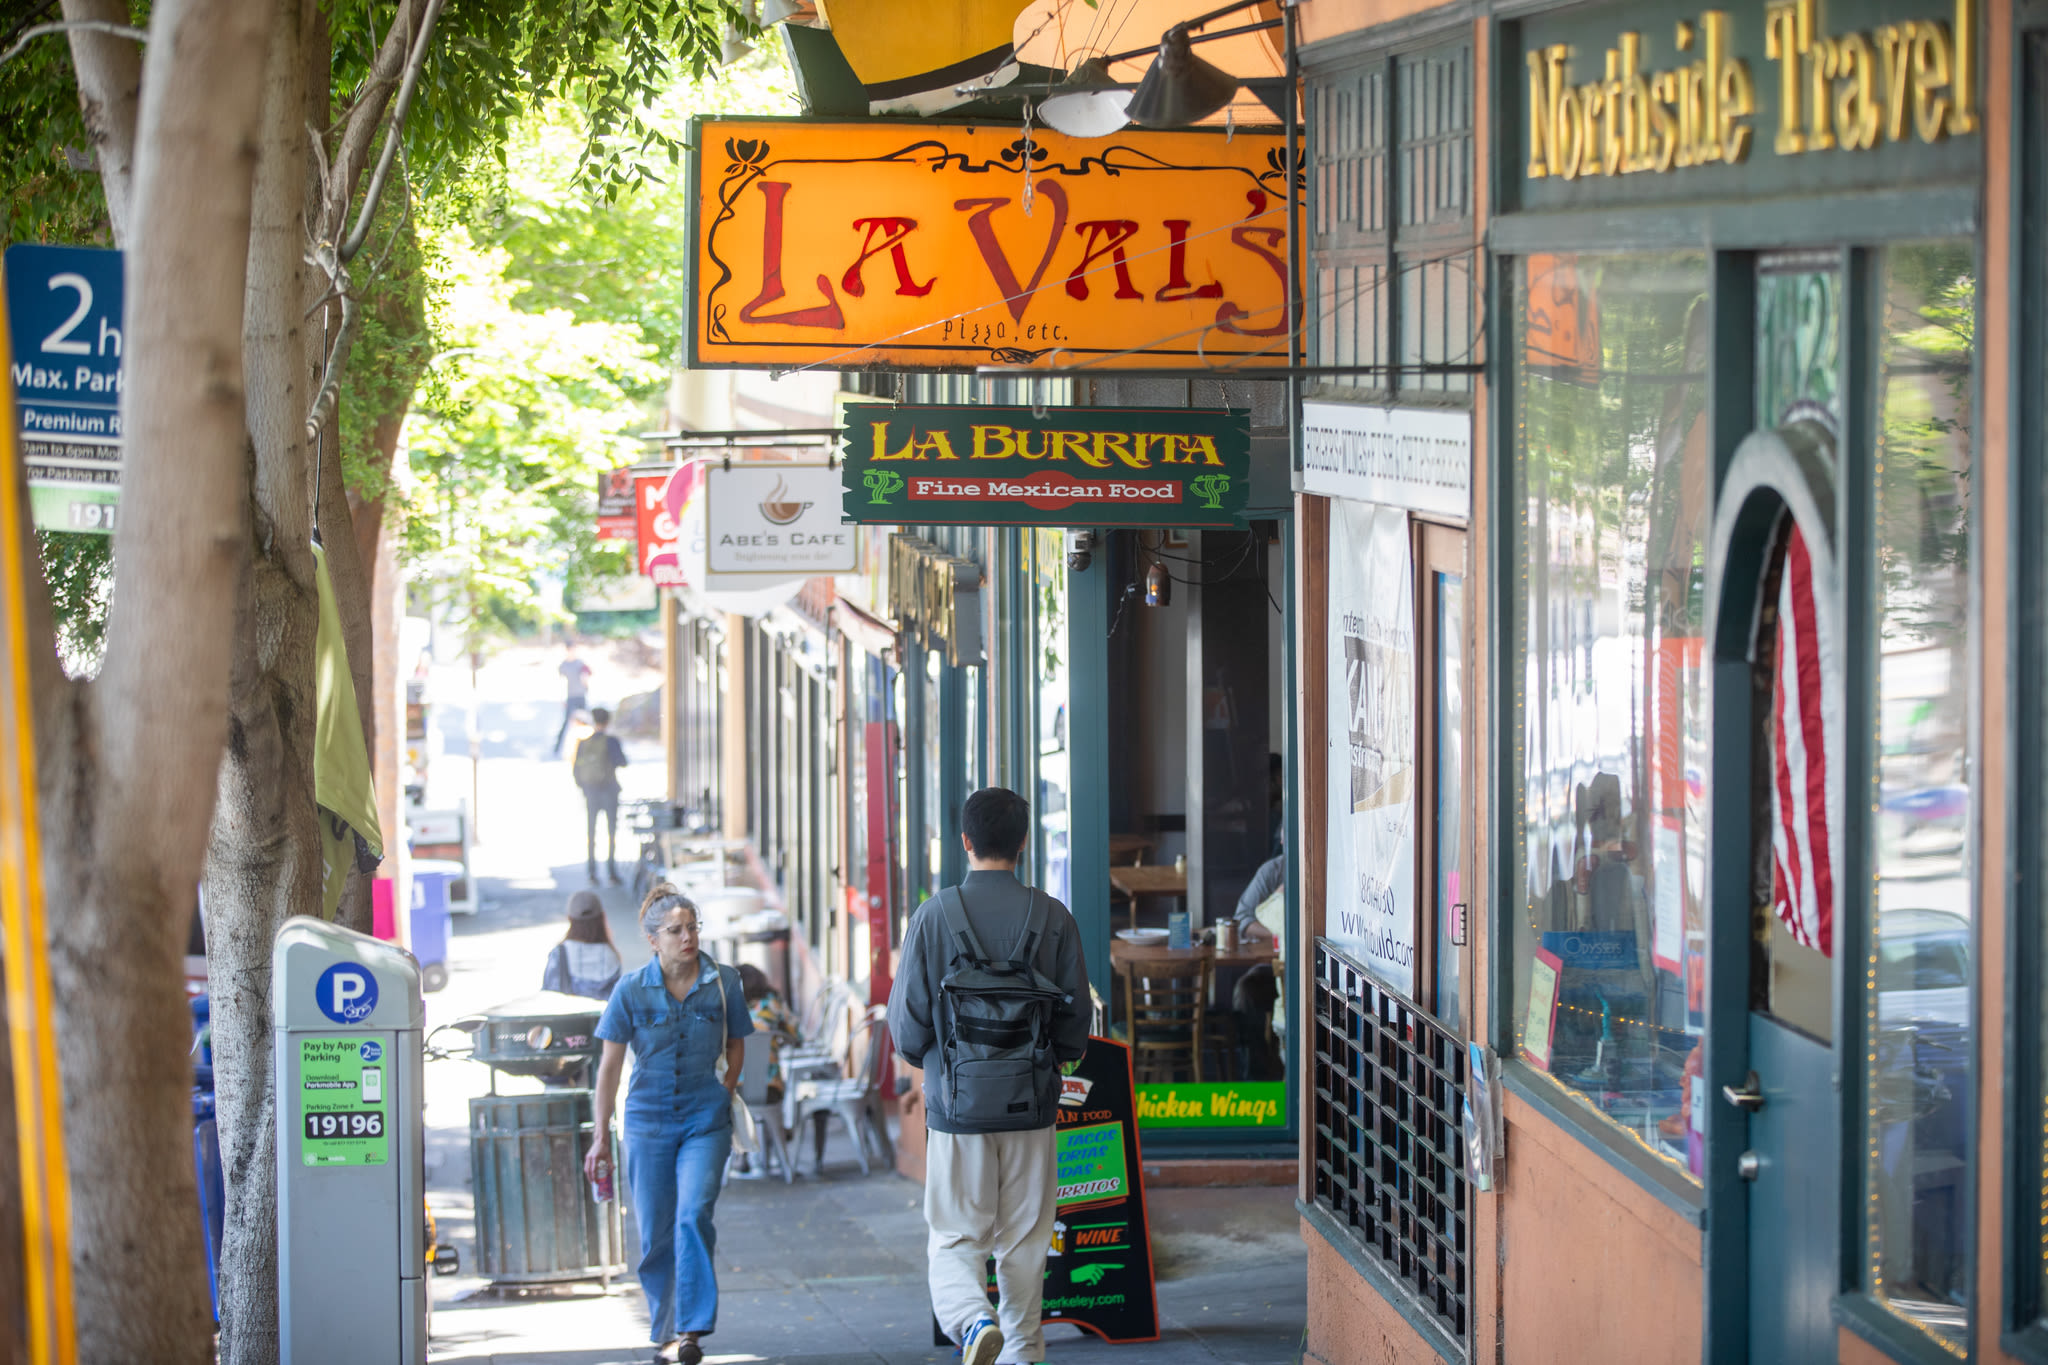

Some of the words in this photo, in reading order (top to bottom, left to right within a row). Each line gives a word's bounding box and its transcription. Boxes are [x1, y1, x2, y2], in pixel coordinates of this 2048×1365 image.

[1527, 10, 1754, 180] Northside
[1766, 0, 1980, 155] Travel
[739, 181, 937, 330] LA
[40, 272, 93, 355] 2
[98, 316, 122, 357] h
[11, 362, 68, 390] Max.
[24, 408, 105, 433] Premium
[869, 421, 960, 462] LA
[969, 424, 1225, 469] BURRITA
[47, 467, 93, 483] Parking
[916, 480, 981, 496] Fine
[988, 481, 1102, 498] Mexican
[1108, 484, 1175, 499] Food
[71, 503, 116, 530] 191
[719, 530, 779, 547] ABE'S
[790, 532, 845, 546] CAFE
[332, 972, 366, 1013] P
[304, 1042, 321, 1052] Pay
[323, 1041, 335, 1052] by
[337, 1041, 357, 1052] App
[304, 1053, 341, 1063] Parking
[1083, 1109, 1113, 1121] FOOD
[1136, 1090, 1203, 1119] hicken
[1211, 1090, 1277, 1124] Wings
[308, 1114, 382, 1136] 19196
[1067, 1129, 1117, 1147] TACOS
[1057, 1145, 1108, 1163] ORTAS
[1075, 1228, 1124, 1245] WINE
[1042, 1294, 1125, 1310] berkeley.com
